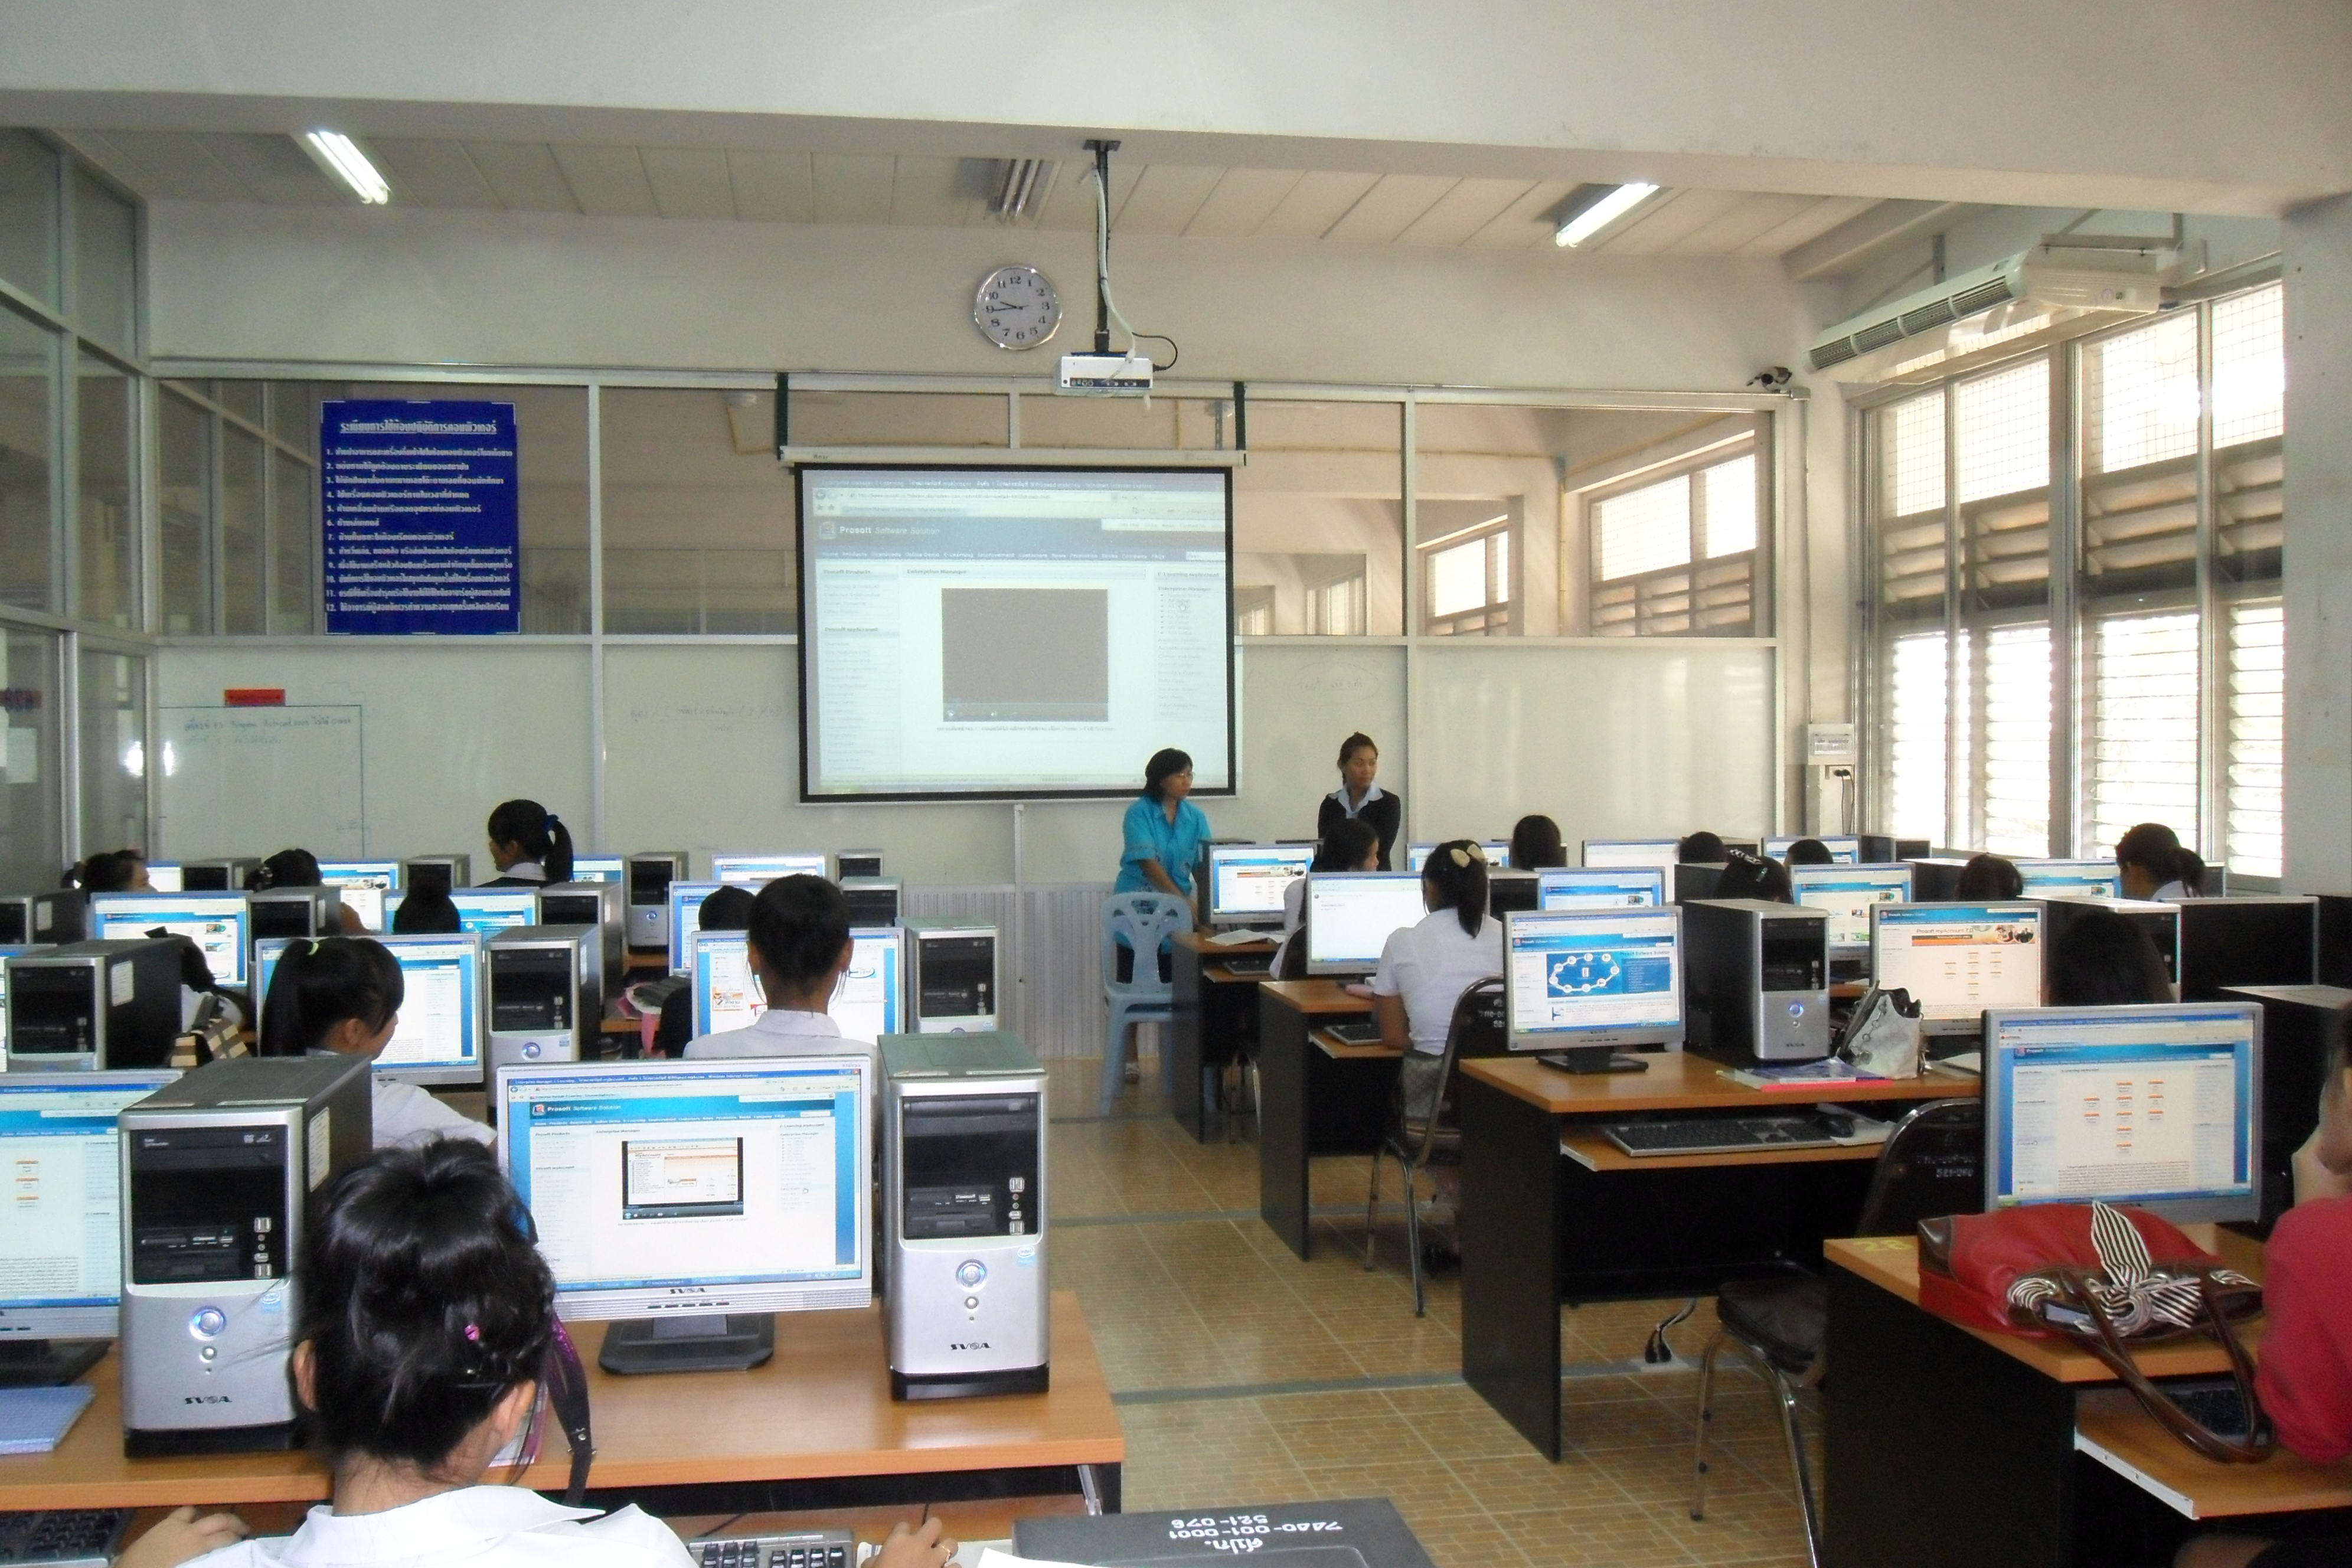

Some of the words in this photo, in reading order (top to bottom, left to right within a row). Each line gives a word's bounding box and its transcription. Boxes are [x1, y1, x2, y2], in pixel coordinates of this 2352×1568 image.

[998, 280, 1006, 288] 11
[1038, 316, 1046, 324] 4
[1003, 329, 1010, 337] 7
[1017, 331, 1025, 339] 6
[950, 1342, 992, 1351] SVOA
[185, 1396, 233, 1405] SVOA
